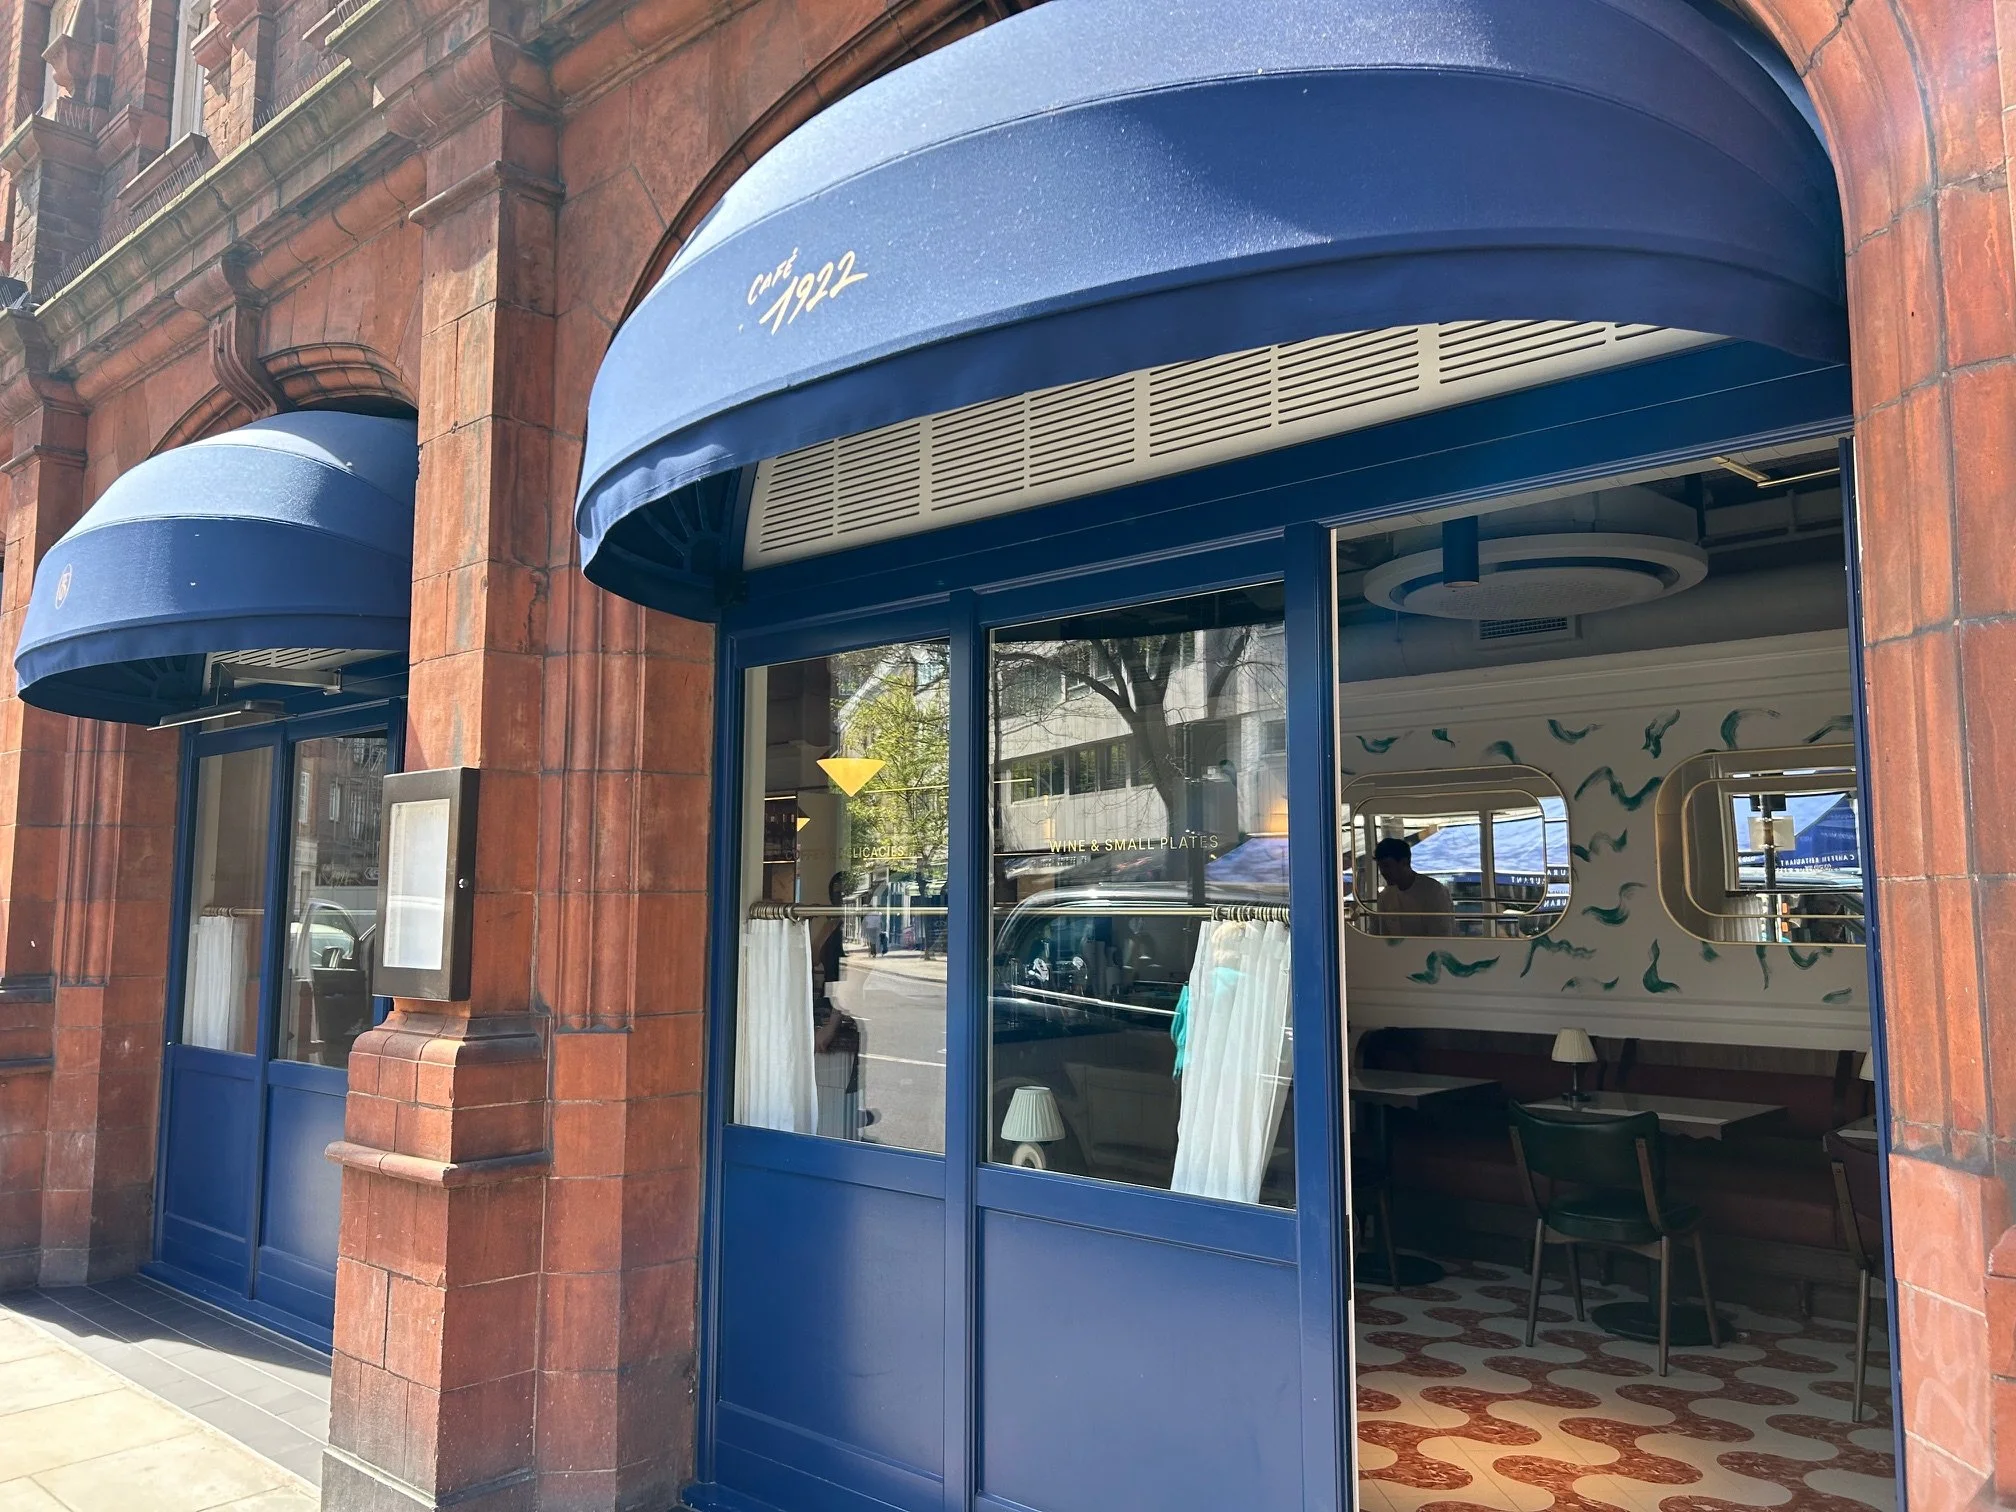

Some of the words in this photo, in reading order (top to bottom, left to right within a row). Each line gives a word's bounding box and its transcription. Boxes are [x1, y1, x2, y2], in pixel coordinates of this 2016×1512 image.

[758, 250, 869, 336] 1922
[1049, 839, 1086, 853] WINE
[1090, 839, 1100, 852] &
[1104, 837, 1155, 851] SMALL
[1160, 834, 1219, 850] PLATES
